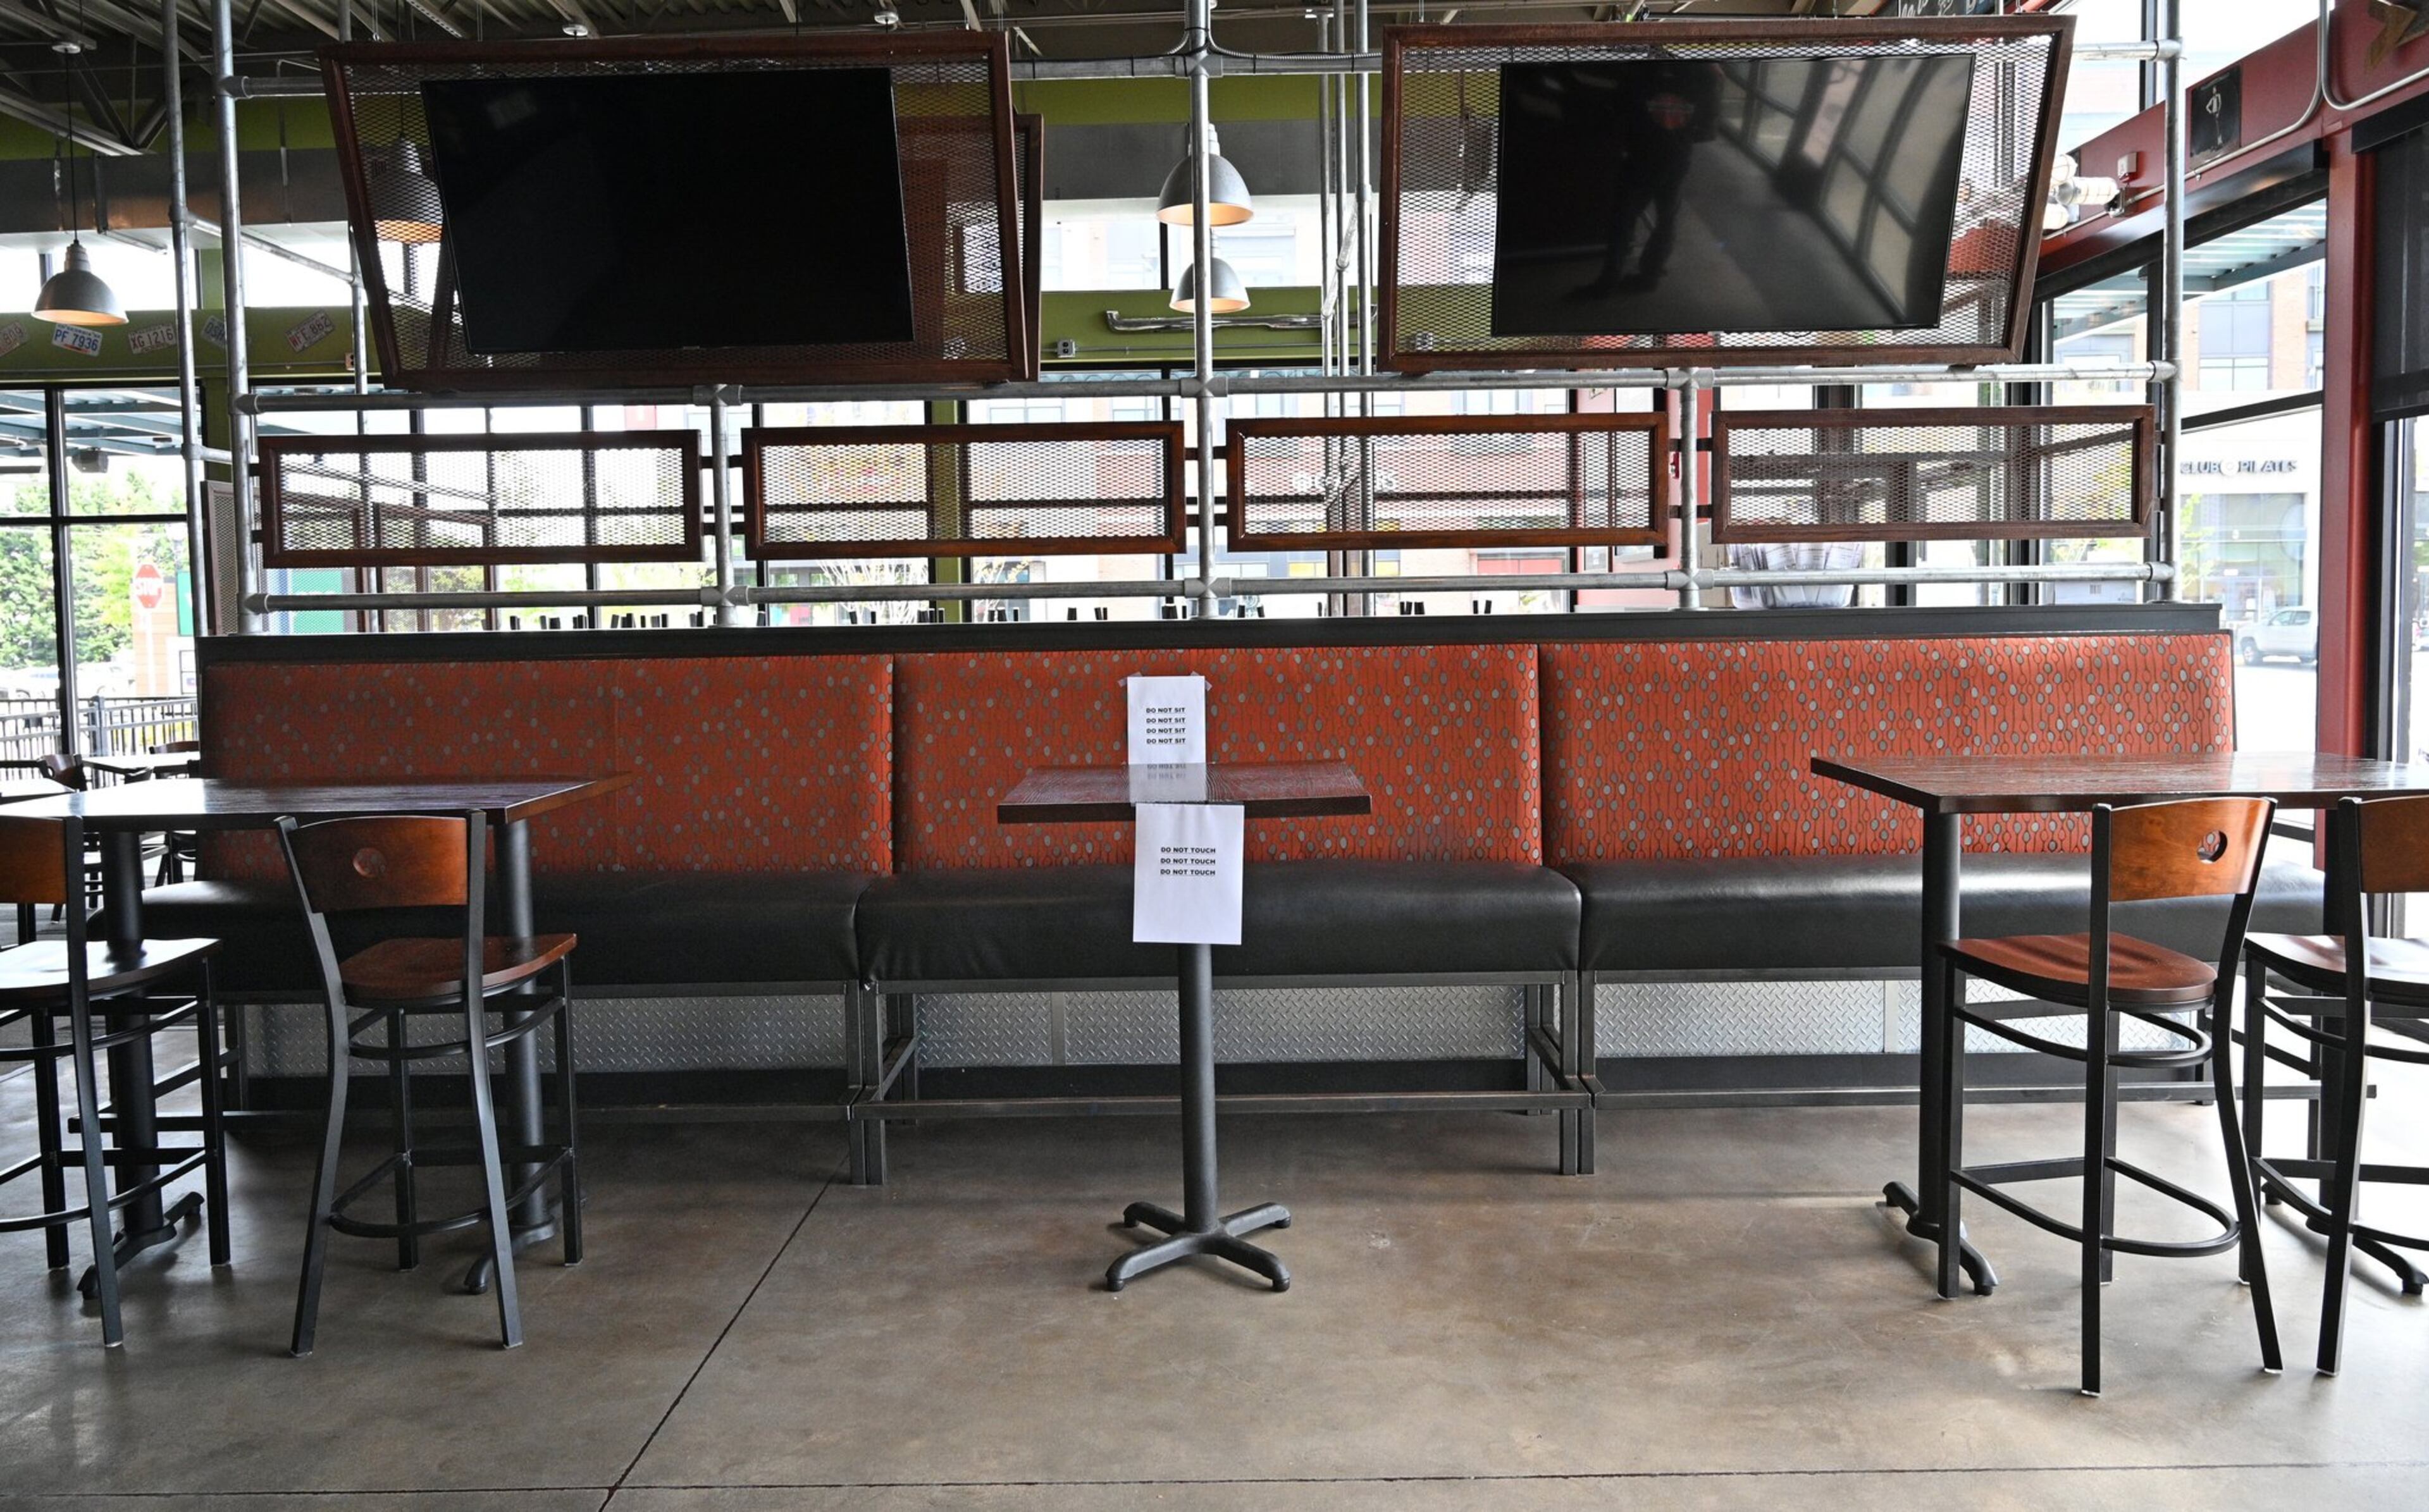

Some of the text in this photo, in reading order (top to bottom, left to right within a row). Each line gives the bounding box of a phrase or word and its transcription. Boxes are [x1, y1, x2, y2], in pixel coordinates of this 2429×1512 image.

[54, 329, 69, 342] PF
[71, 333, 99, 352] 7936
[130, 328, 174, 350] XG 1216
